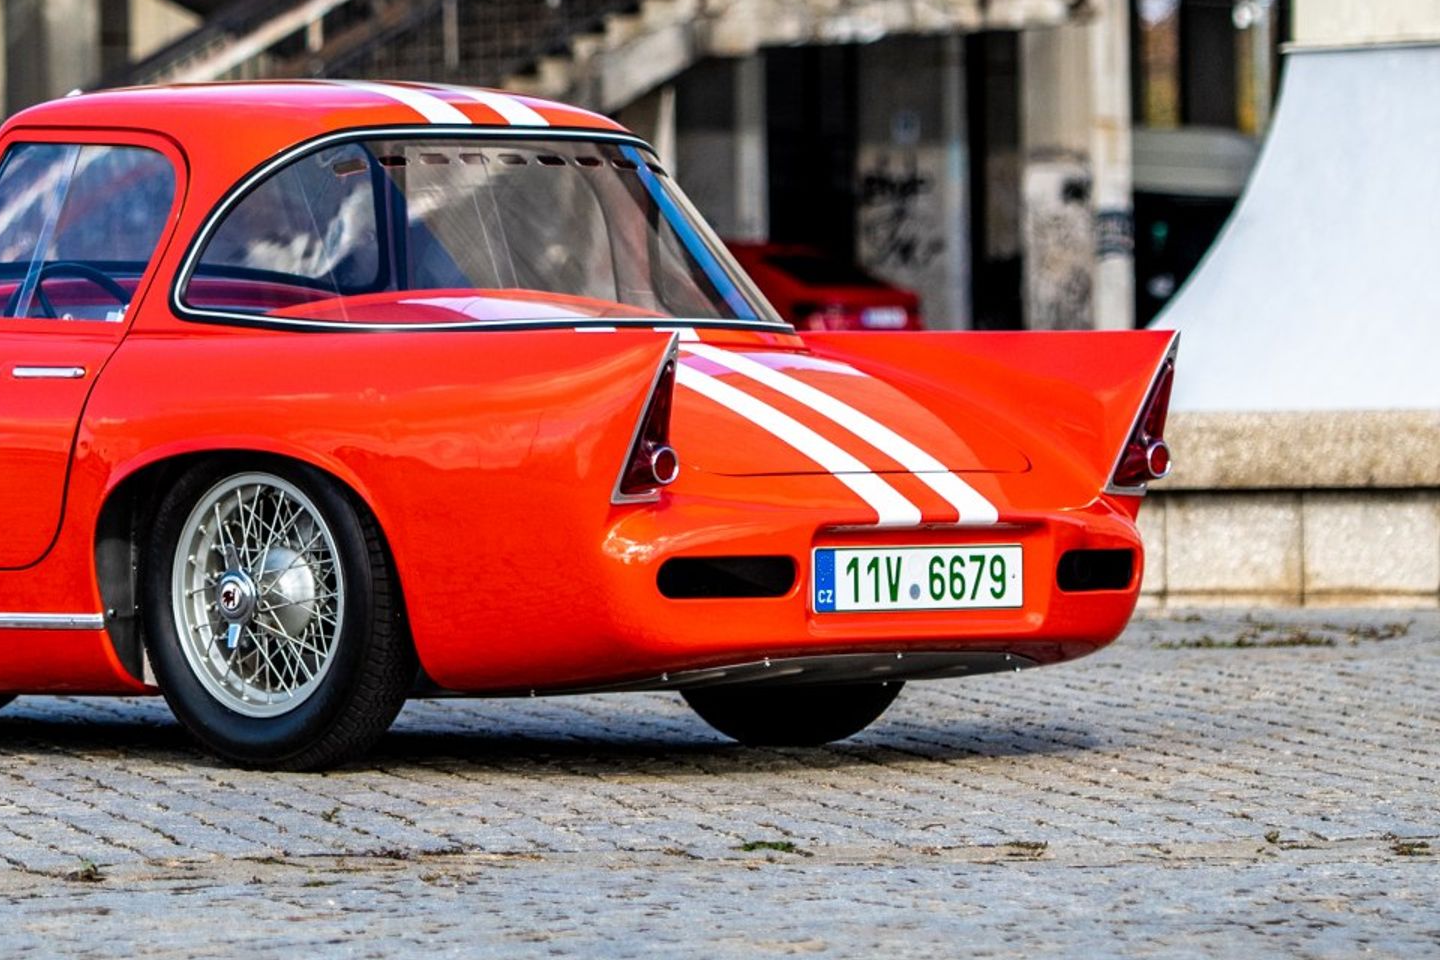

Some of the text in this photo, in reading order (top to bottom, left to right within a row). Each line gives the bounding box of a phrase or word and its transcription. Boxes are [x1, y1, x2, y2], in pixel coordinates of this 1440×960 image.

[846, 554, 1006, 603] 11V 6679
[817, 589, 834, 605] CZ
